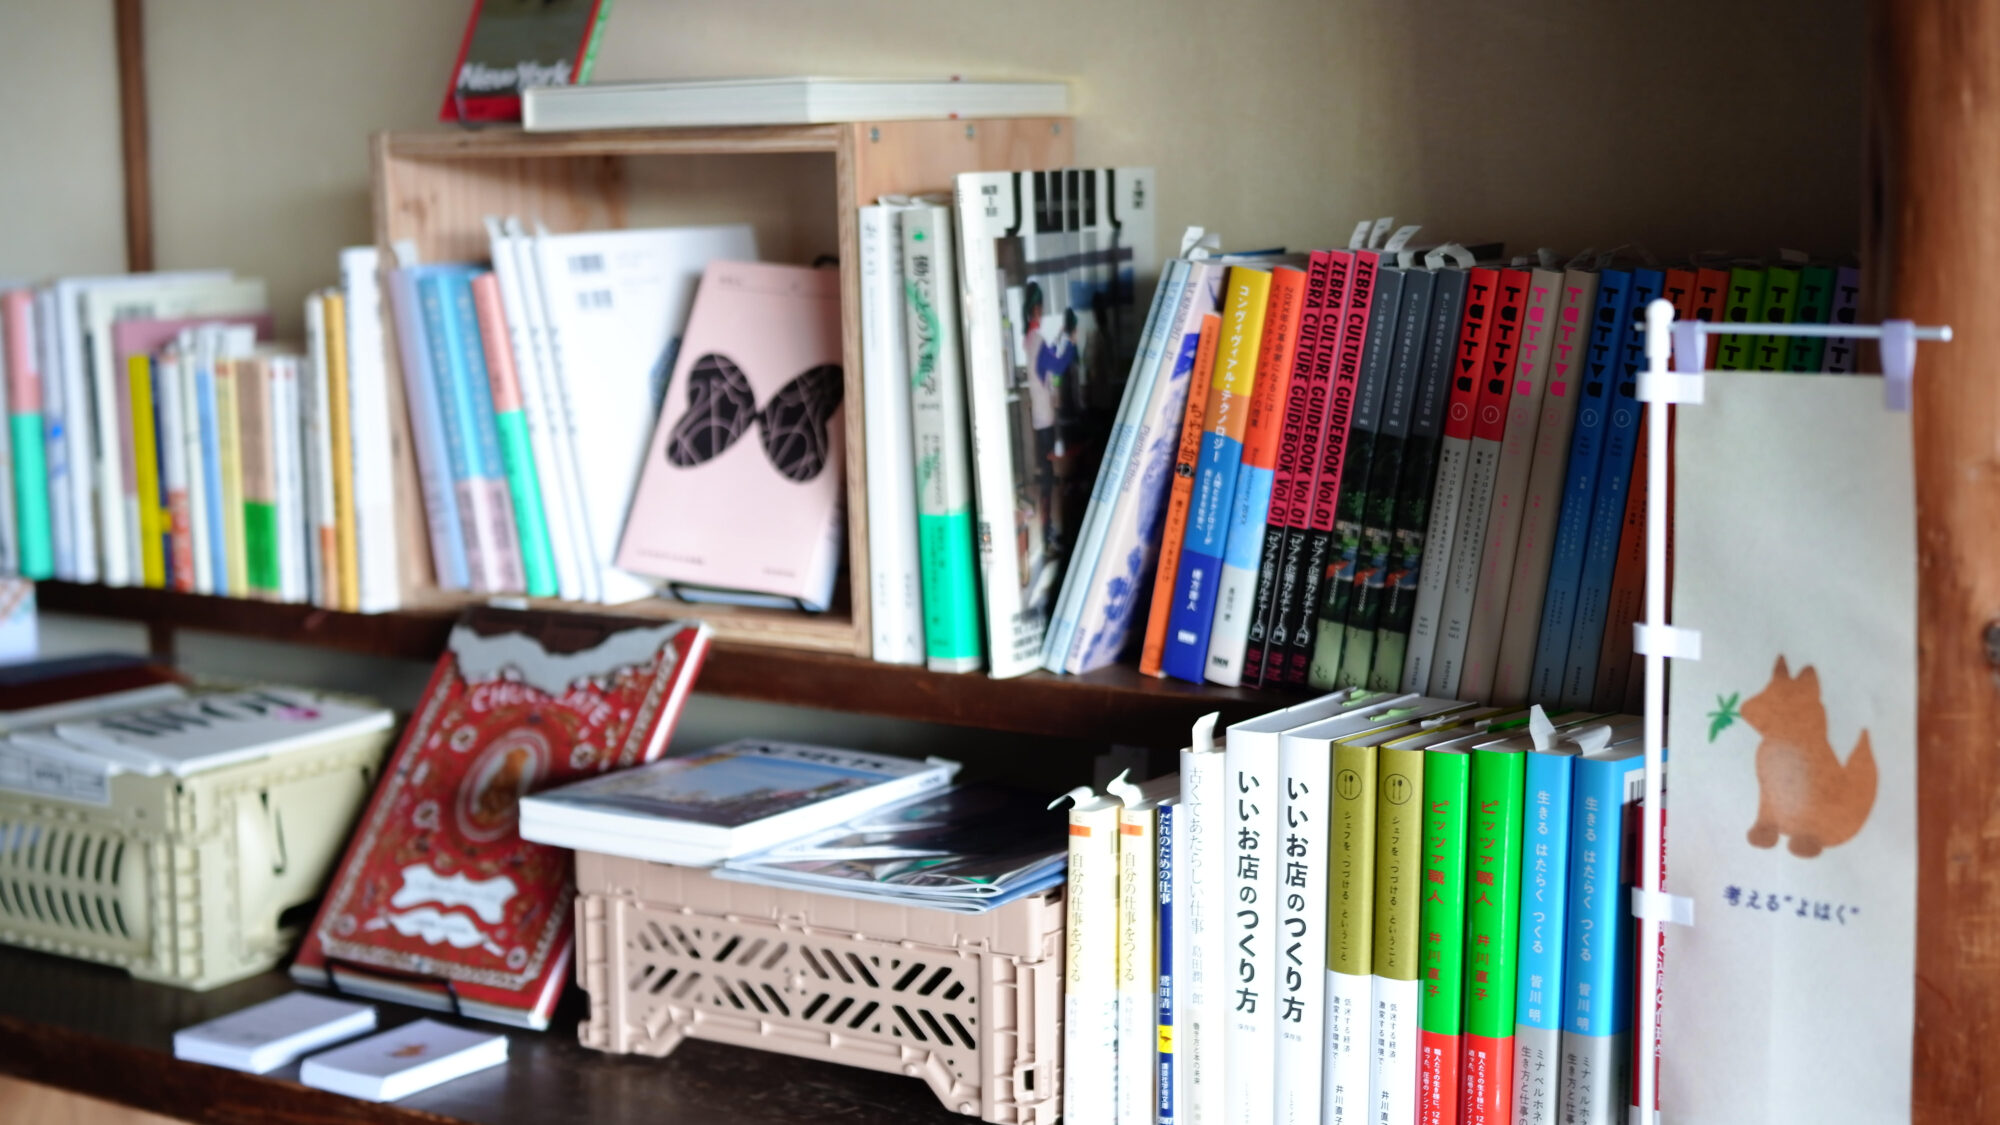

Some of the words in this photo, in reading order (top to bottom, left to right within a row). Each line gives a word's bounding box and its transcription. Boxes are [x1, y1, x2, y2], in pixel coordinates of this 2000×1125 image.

[1305, 260, 1328, 310] ZEBRA
[1327, 261, 1348, 308] ZEBRA
[1352, 260, 1374, 309] ZEBRA
[1213, 285, 1249, 462] コンヴィヴィアル・テクノロジー
[1294, 313, 1321, 384] CULTURE
[1313, 312, 1341, 384] CULTURE
[1338, 313, 1364, 385] CULTURE
[1277, 385, 1306, 474] GUIDEBOOK
[1297, 386, 1326, 477] GUIDEBOOK
[1322, 386, 1351, 479] GUIDEBOOK
[1269, 475, 1292, 527] Vol.01
[1290, 475, 1312, 528] Vol.01
[1315, 475, 1337, 528] Vol.01
[1537, 789, 1550, 836] 生きる
[1584, 796, 1599, 842] 生きる
[1159, 813, 1172, 905] だれのための仕事
[1189, 767, 1203, 935] 古くてあたらしい仕事
[1427, 800, 1449, 904] ピッツァ職人
[1476, 800, 1499, 906] ピッツァ職人
[1535, 843, 1549, 902] はたらく
[1583, 850, 1597, 909] はたらく
[1070, 853, 1084, 983] 自分の仕事をつくる
[1123, 852, 1137, 982] 自分の仕事をつくる
[1236, 771, 1260, 1014] いいお店のつくり方
[1282, 777, 1309, 1023] いいお店のつくり方
[1427, 932, 1441, 998] 井川直子
[1531, 911, 1546, 954] つくる
[1580, 919, 1594, 961] つくる
[1475, 934, 1490, 1000] 井川直子
[1381, 1090, 1389, 1125] 井川直
